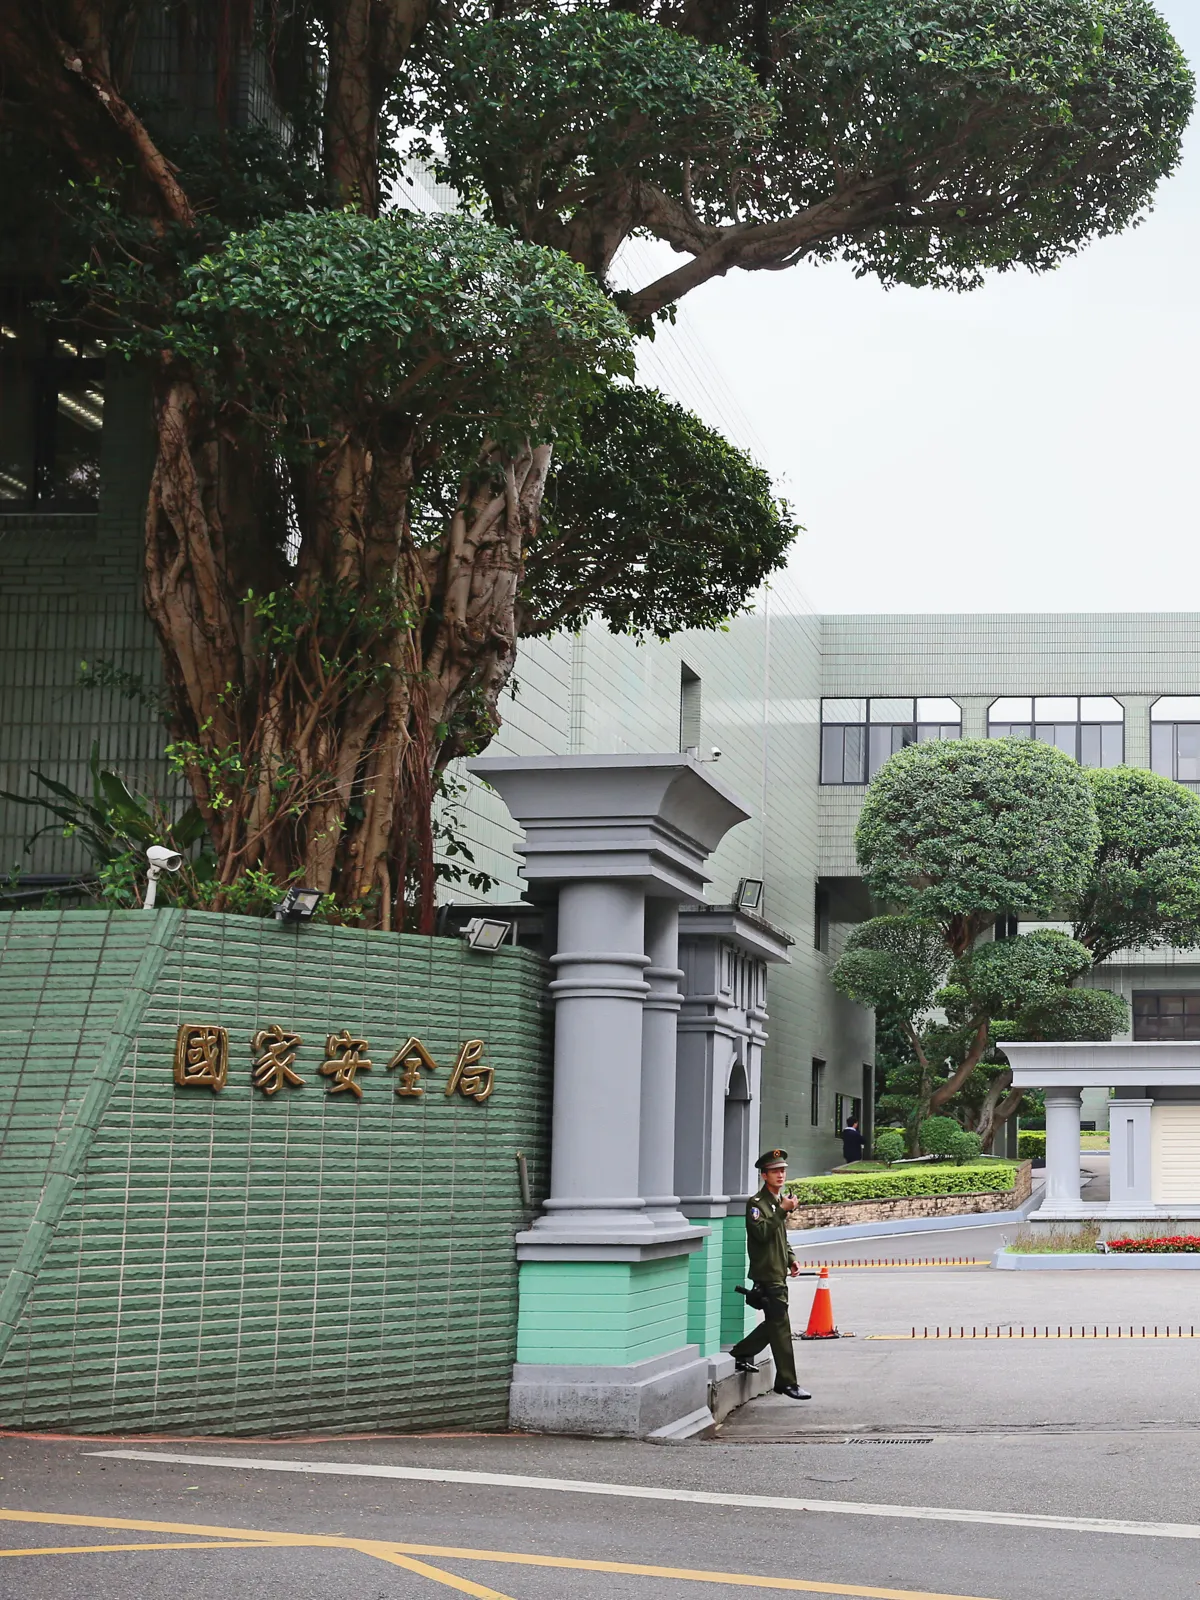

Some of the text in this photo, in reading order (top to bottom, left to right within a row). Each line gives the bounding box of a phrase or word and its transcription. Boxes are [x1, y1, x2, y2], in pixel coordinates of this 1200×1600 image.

[173, 1023, 496, 1103] 國家安全局
